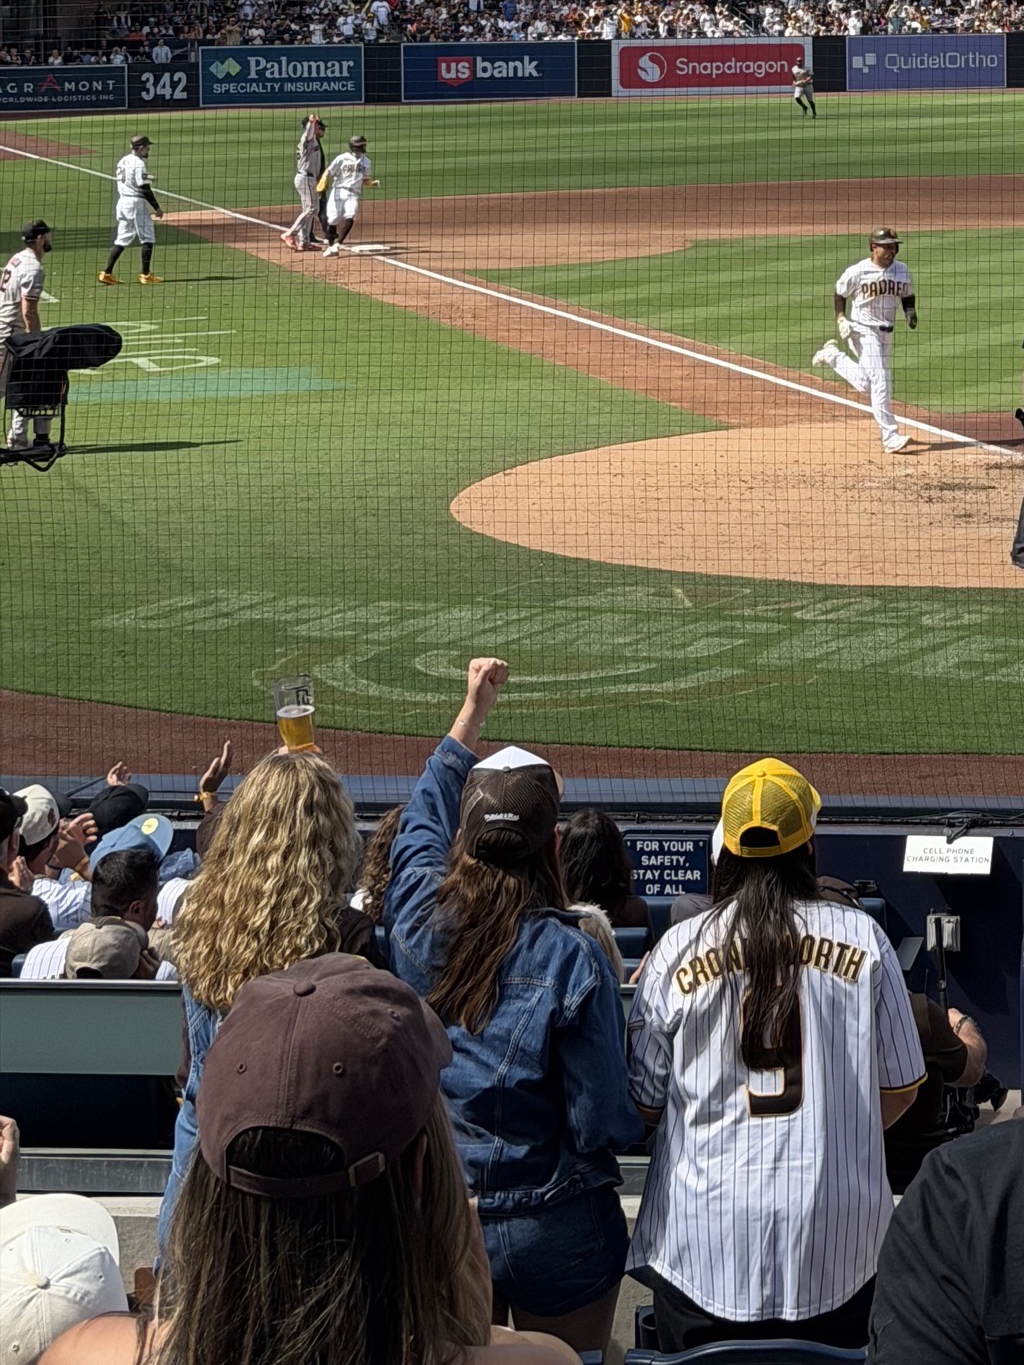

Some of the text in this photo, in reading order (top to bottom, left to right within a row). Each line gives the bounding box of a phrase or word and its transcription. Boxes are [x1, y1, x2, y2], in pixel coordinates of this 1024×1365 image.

[247, 56, 354, 79] Palomar
[440, 55, 539, 80] us bank
[675, 57, 789, 79] Snapdragon
[884, 51, 998, 72] QuidelOrtho
[140, 71, 188, 101] 342
[213, 81, 356, 94] SPECIALTY INSURANCE
[636, 841, 694, 852] FOR YOUR
[923, 847, 943, 855] CELL
[641, 856, 689, 867] SAFETY,
[906, 855, 990, 863] CHARGING STATION
[631, 870, 701, 880] STAY CLEAR
[645, 884, 686, 894] OF ALL
[674, 934, 869, 996] CRONORTH
